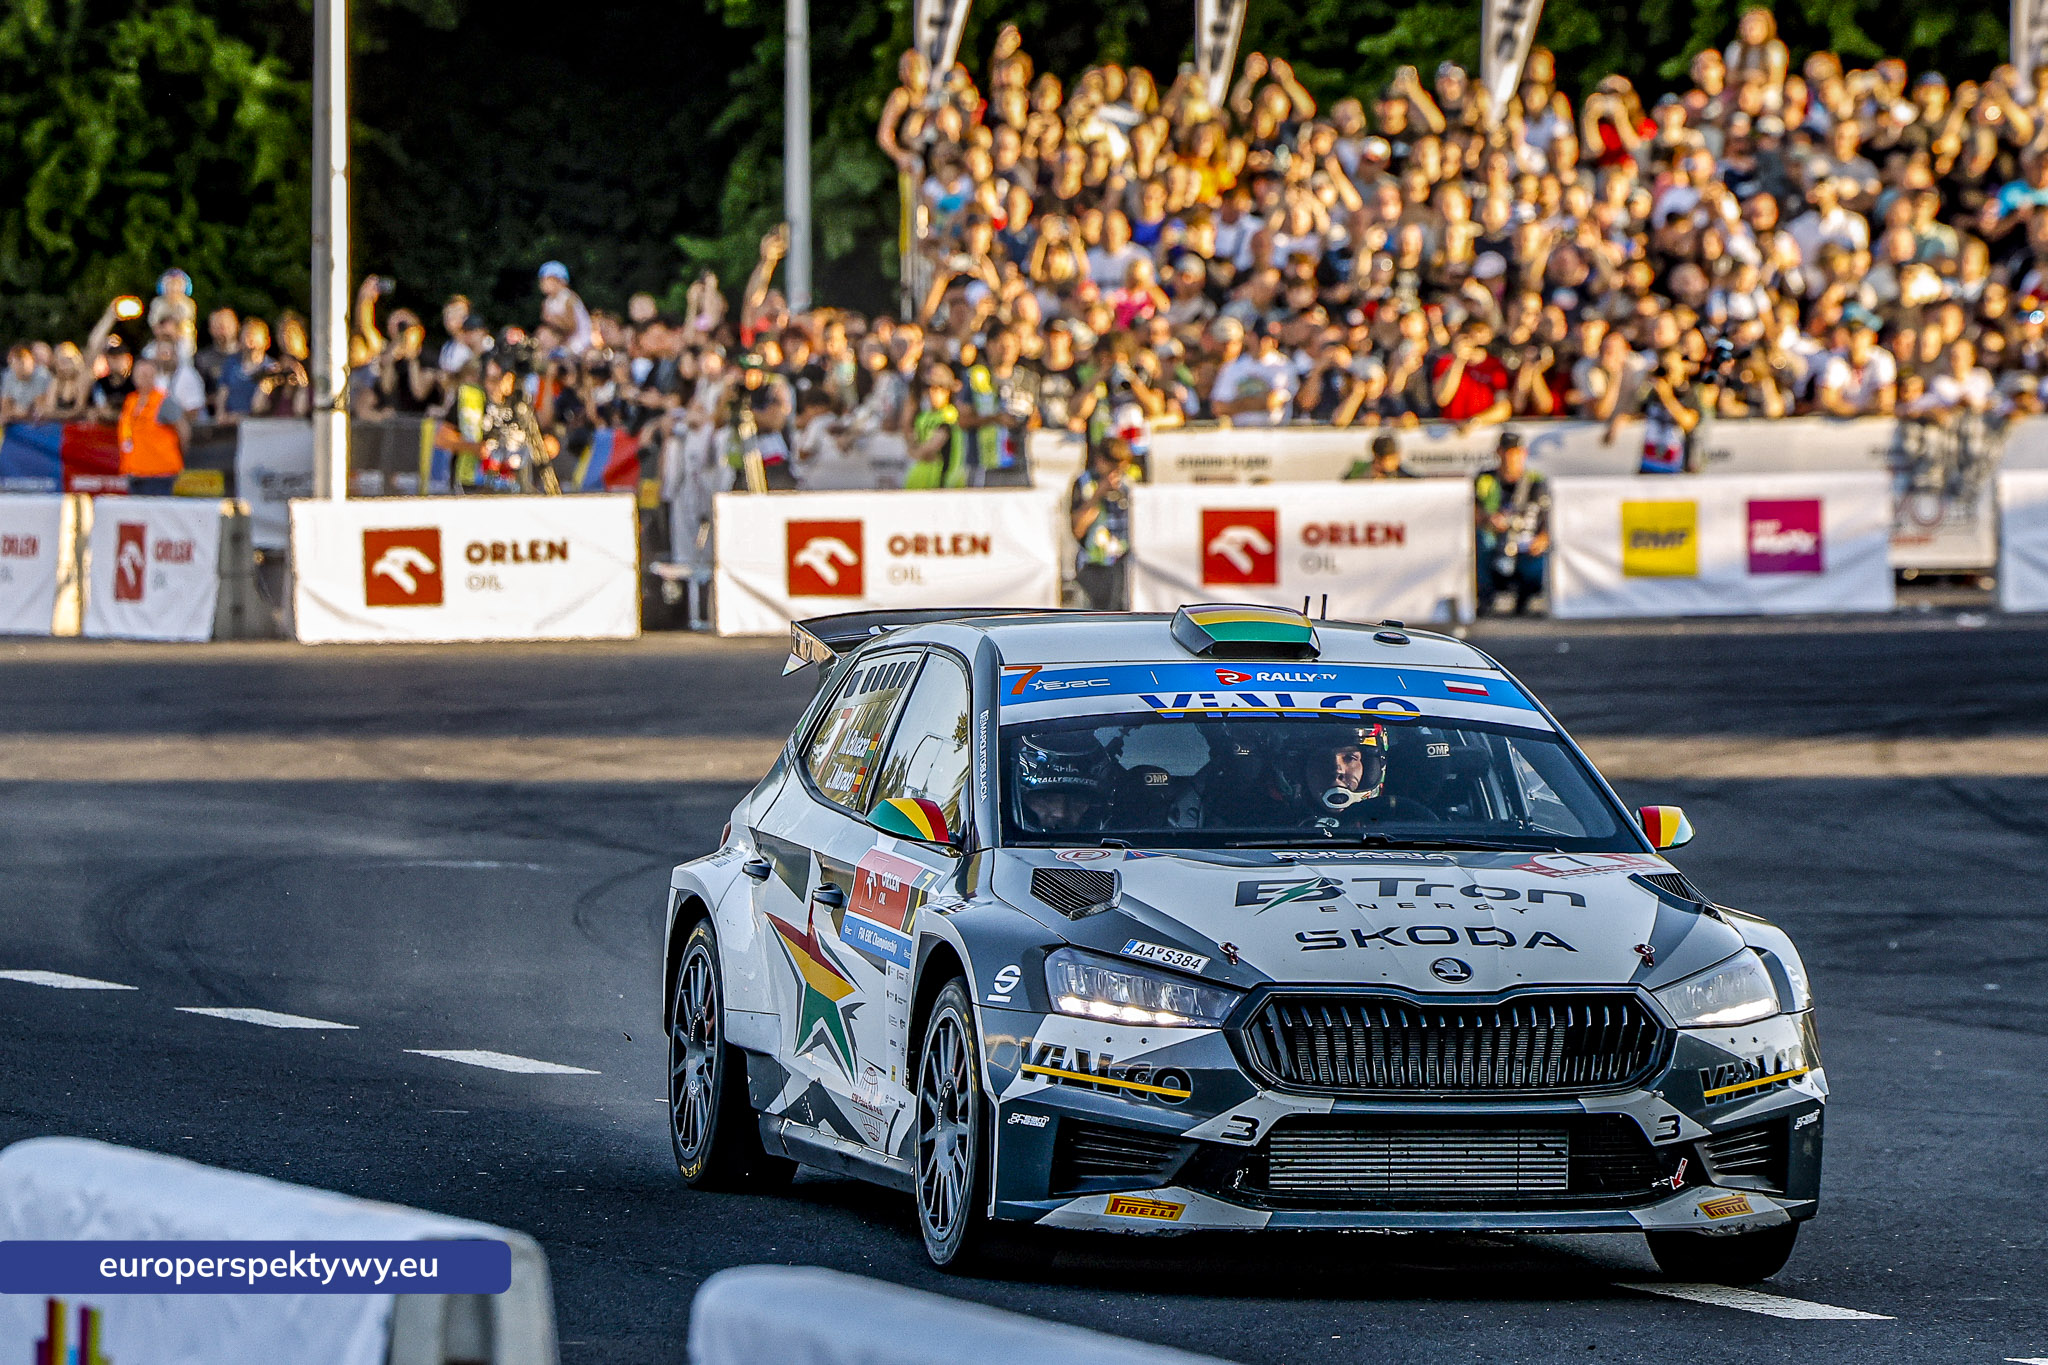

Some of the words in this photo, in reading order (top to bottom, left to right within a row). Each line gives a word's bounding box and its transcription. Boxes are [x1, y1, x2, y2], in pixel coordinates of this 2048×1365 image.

[1301, 522, 1406, 547] ORLEN
[465, 538, 568, 564] ORLEN
[887, 533, 991, 557] ORLEN
[1300, 553, 1341, 574] OIL
[466, 573, 504, 591] OIL
[888, 565, 926, 585] OIL
[1004, 665, 1043, 695] 7
[1427, 745, 1450, 756] OMP
[1144, 774, 1169, 784] OMP
[1547, 855, 1592, 867] 7
[881, 871, 902, 893] ORLEN
[878, 891, 887, 905] OIL
[1318, 902, 1529, 915] ENERGY
[857, 926, 867, 940] FIA
[1132, 944, 1156, 958] AA
[1162, 950, 1203, 970] S384
[1110, 1198, 1179, 1218] PIRELLI
[1703, 1195, 1749, 1217] PIRELLI
